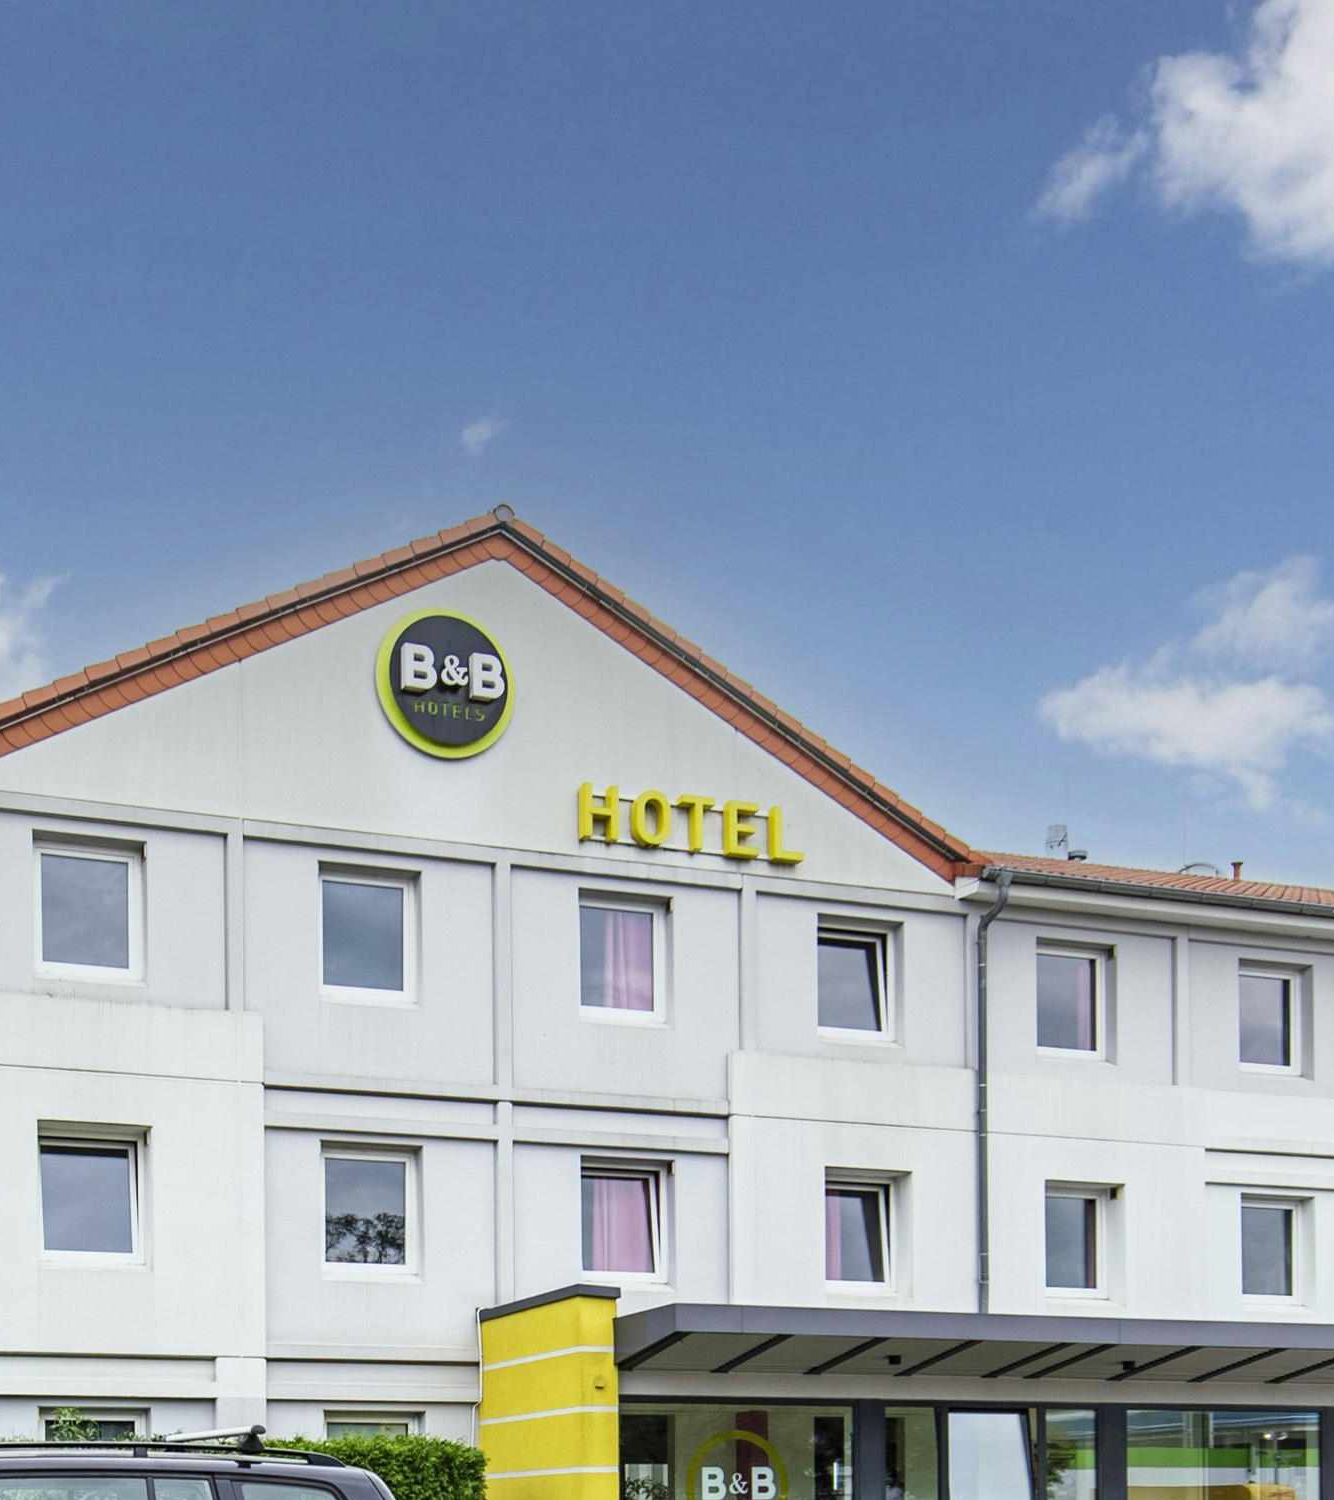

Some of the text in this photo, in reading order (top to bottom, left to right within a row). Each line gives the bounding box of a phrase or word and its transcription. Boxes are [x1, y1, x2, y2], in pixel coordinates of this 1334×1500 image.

[400, 642, 505, 701] B&B
[413, 700, 485, 722] HOTELS
[578, 781, 805, 865] HOTEL
[701, 1466, 777, 1500] B&B
